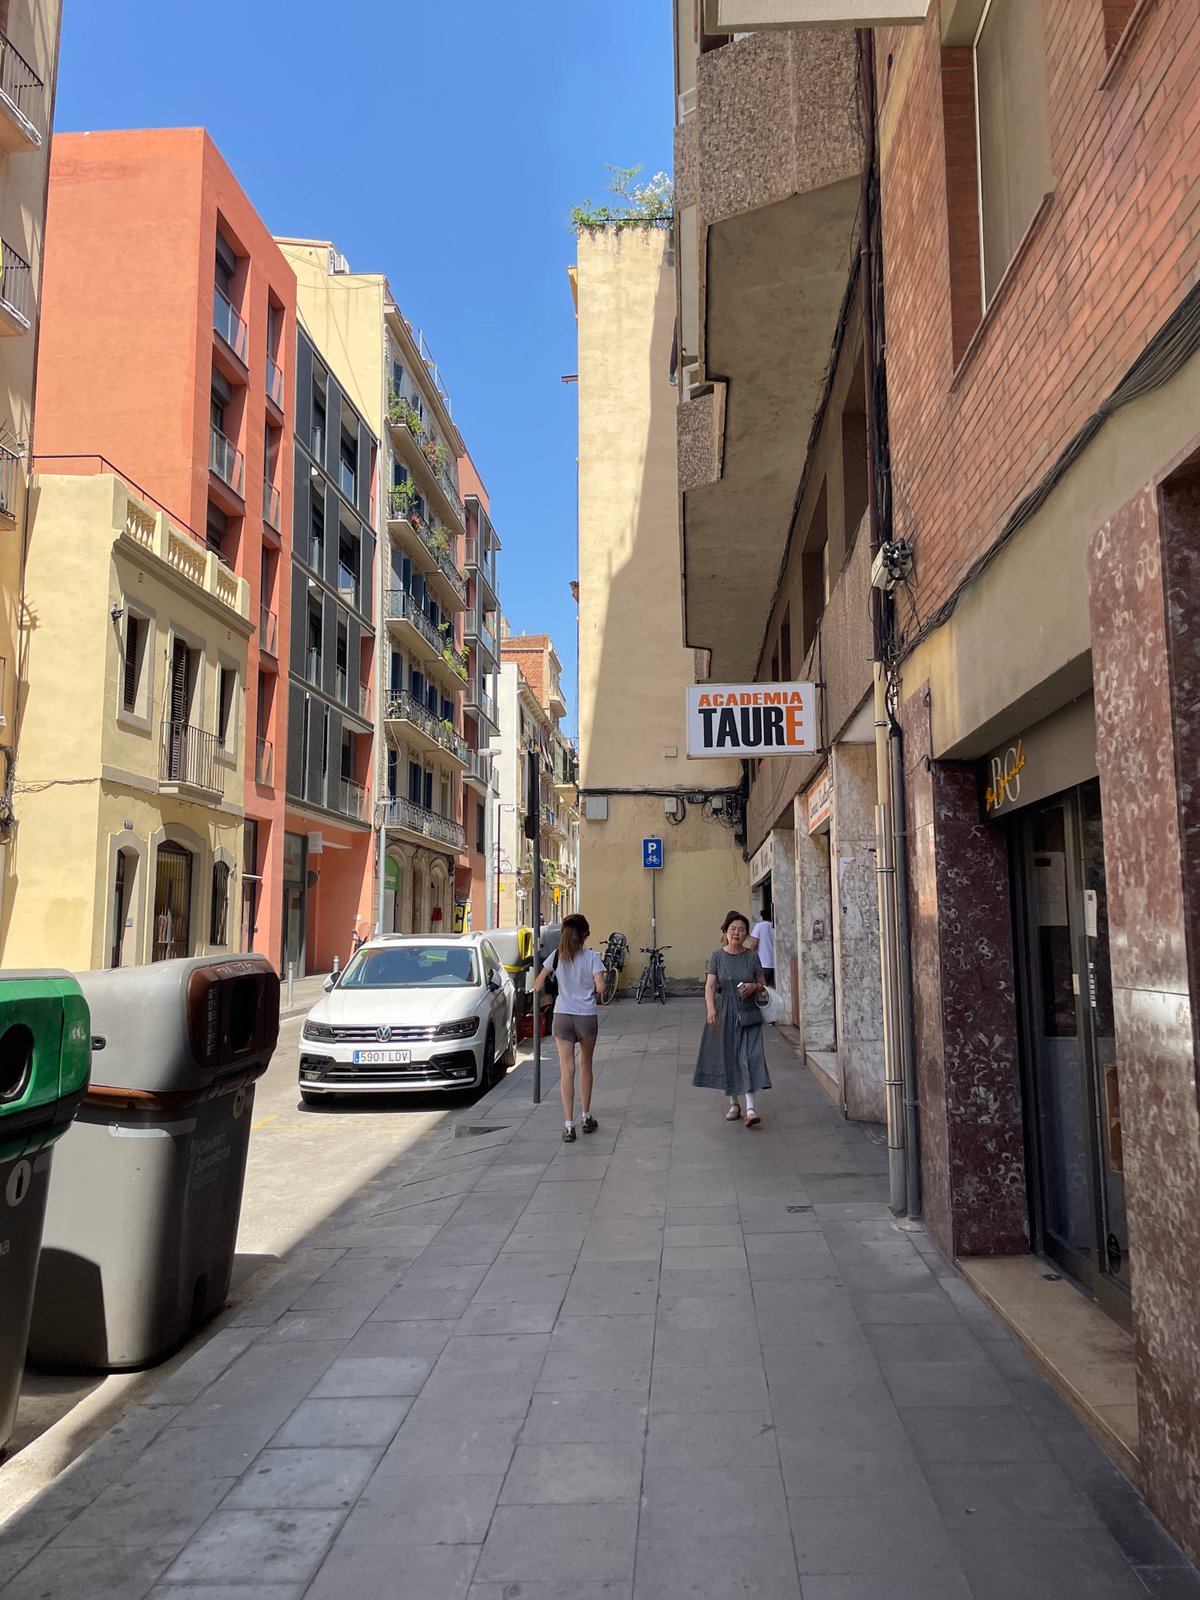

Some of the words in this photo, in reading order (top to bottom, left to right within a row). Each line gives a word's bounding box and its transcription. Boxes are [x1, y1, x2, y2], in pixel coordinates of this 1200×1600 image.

[698, 691, 803, 707] ACADEMIA
[698, 706, 805, 748] TAURE
[360, 1052, 385, 1062] 5901
[389, 1052, 408, 1062] LDV
